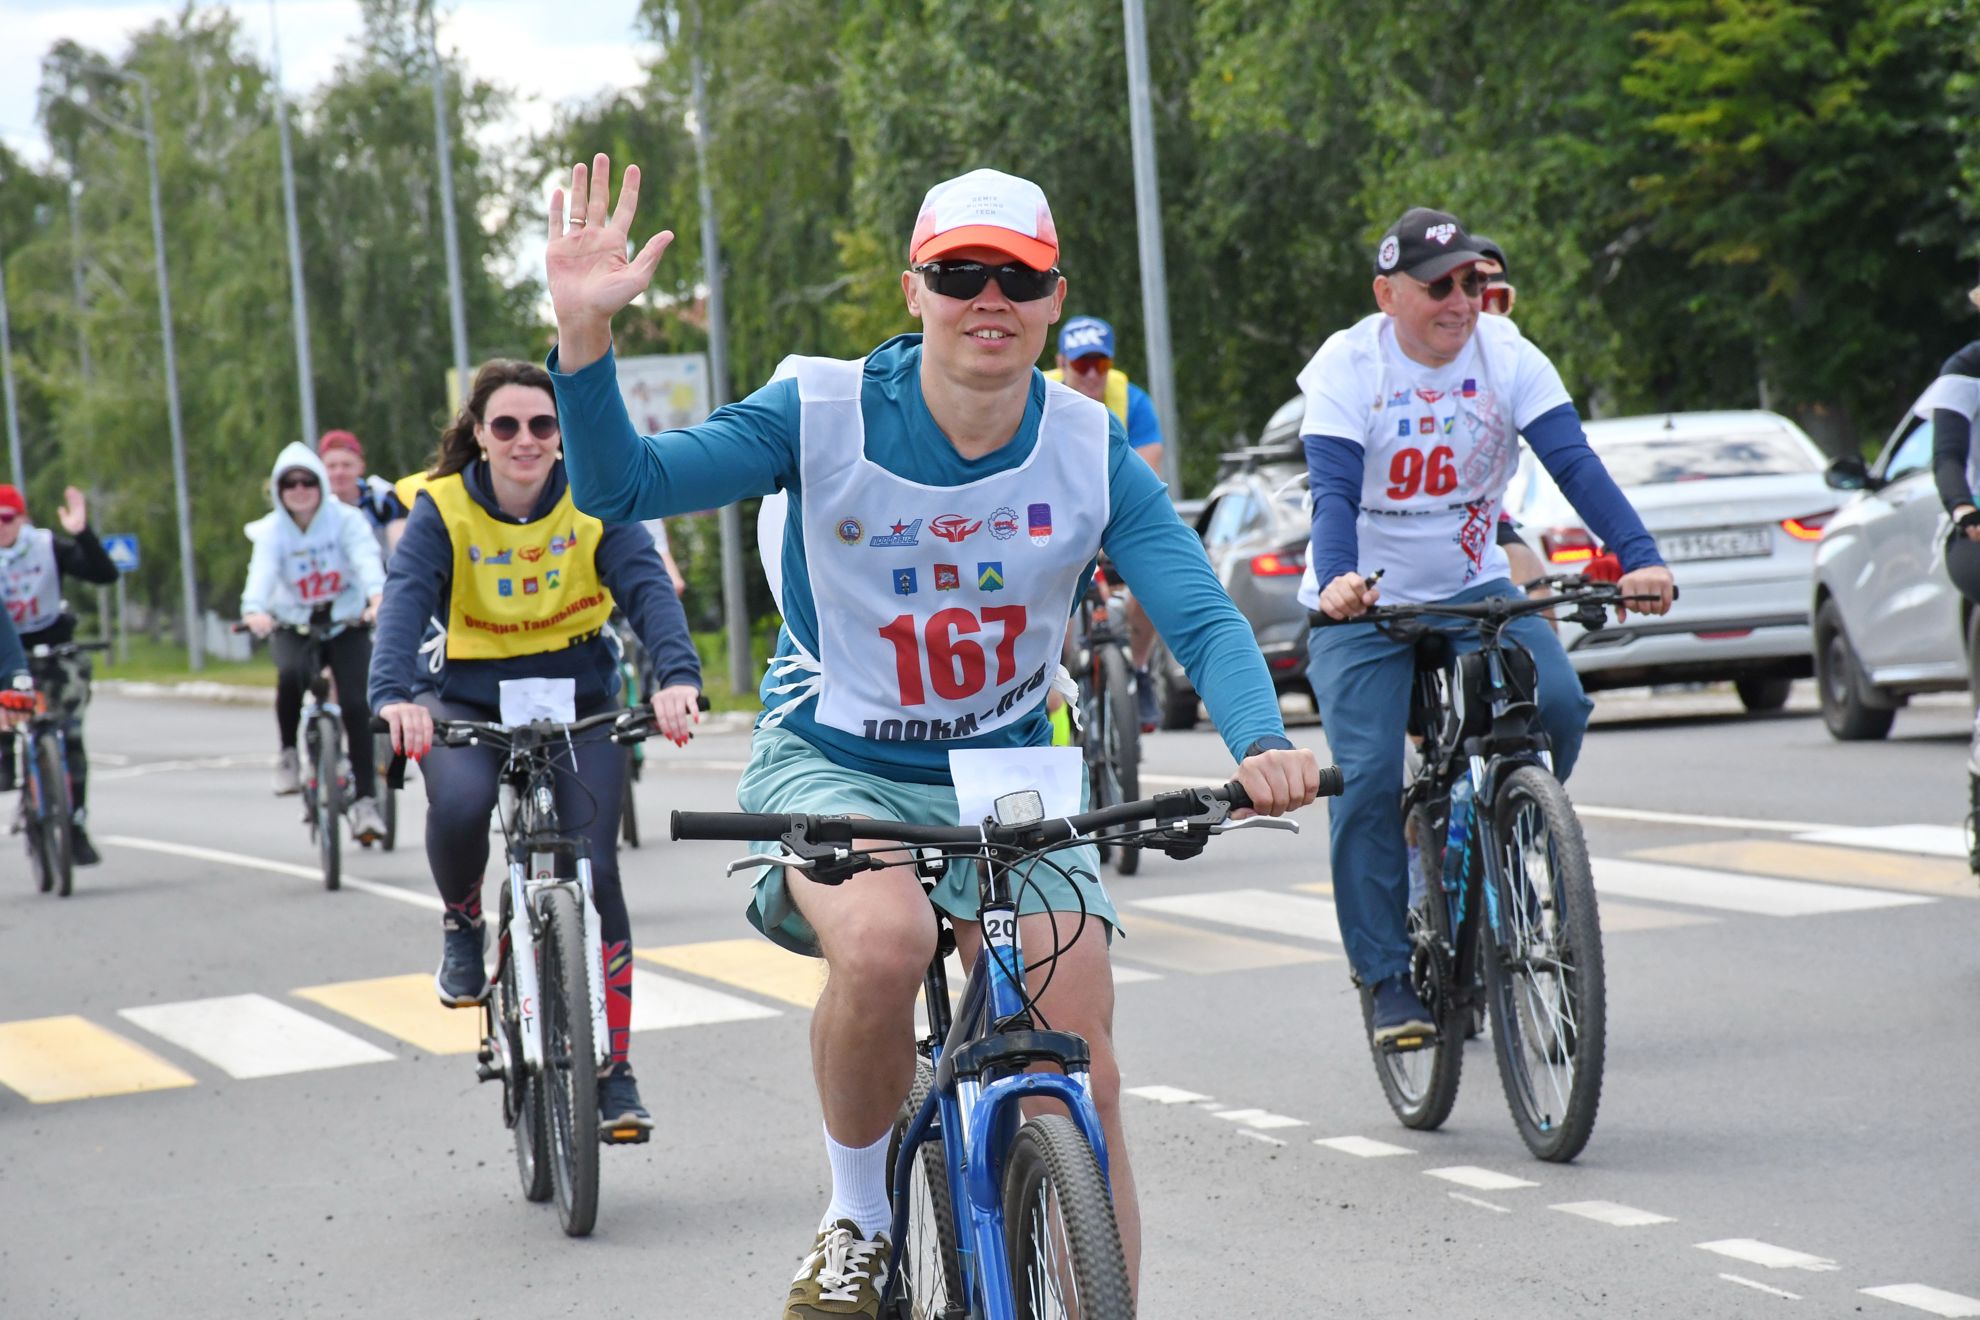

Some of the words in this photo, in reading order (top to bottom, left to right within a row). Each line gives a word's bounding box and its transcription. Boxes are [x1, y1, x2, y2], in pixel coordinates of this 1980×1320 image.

[1386, 445, 1458, 501] 96
[296, 570, 342, 601] 122
[878, 605, 1027, 707] 167
